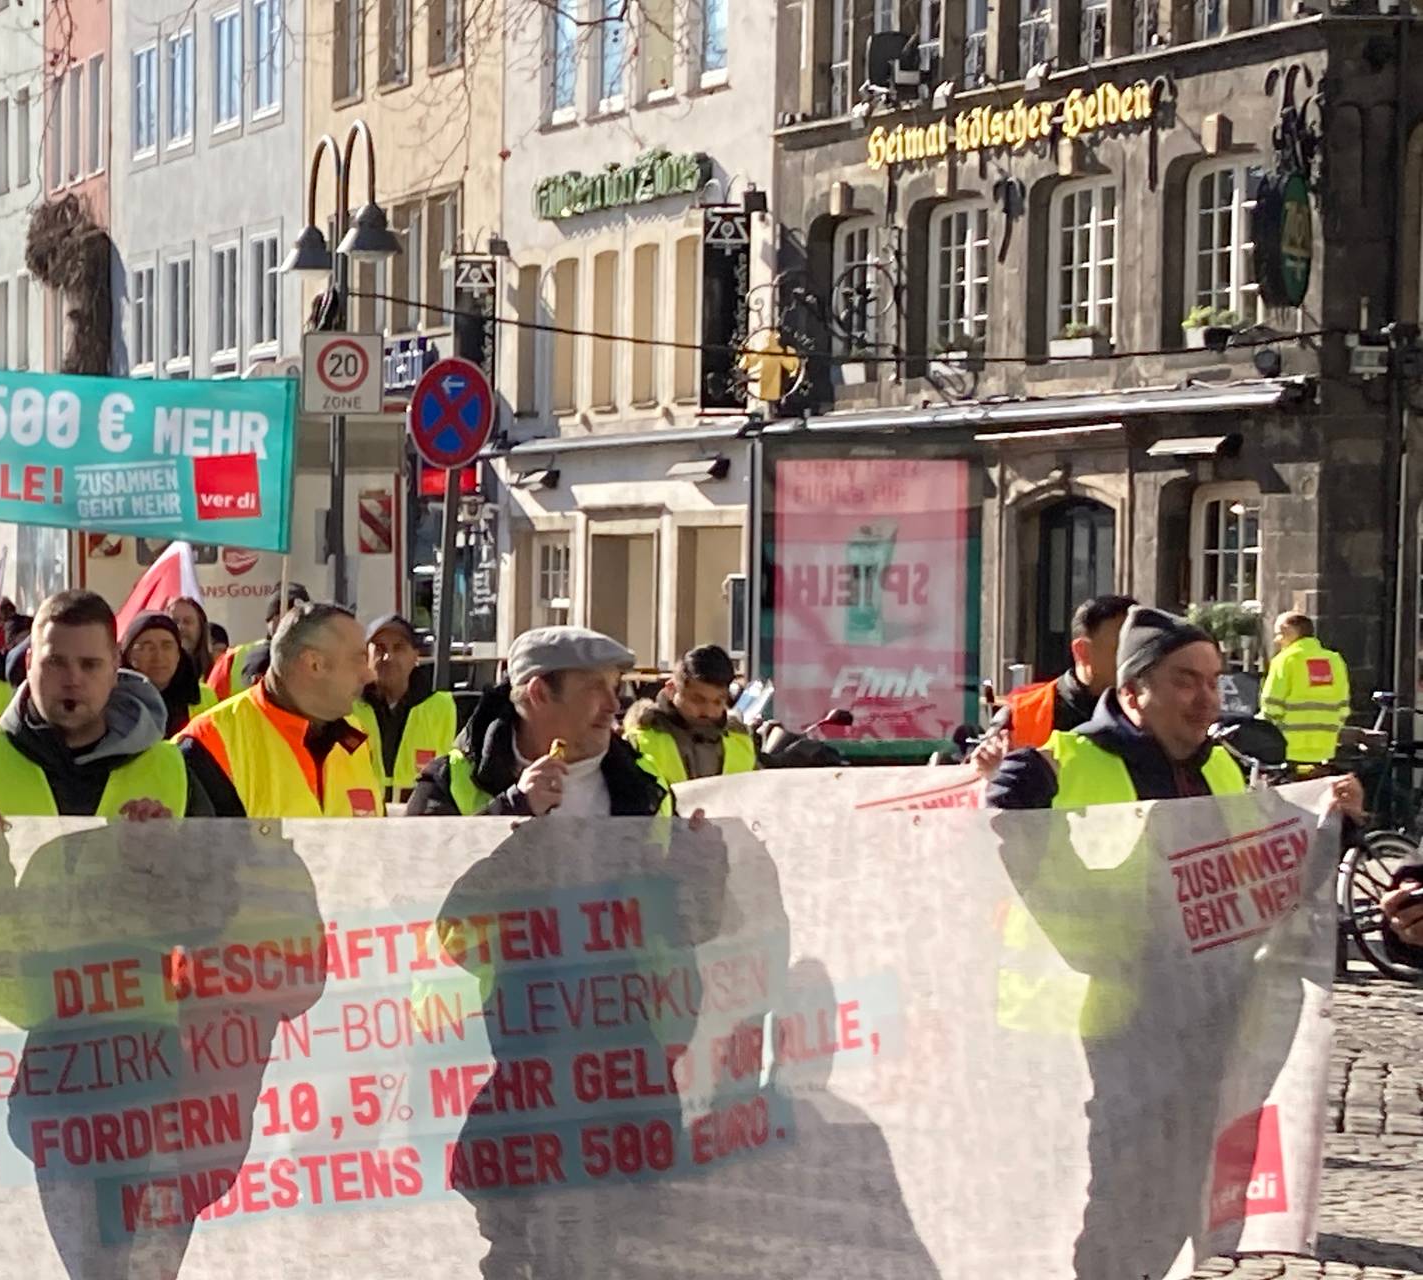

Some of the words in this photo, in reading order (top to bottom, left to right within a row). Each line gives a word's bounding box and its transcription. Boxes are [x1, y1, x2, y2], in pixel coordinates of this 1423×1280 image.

[867, 116, 947, 170] Heimat
[1063, 81, 1153, 138] Helden
[329, 353, 359, 377] 20
[98, 392, 135, 453] €
[153, 406, 269, 459] MEHR
[322, 396, 362, 410] ZONE
[75, 467, 179, 496] ZUSAMMEN
[77, 497, 126, 518] GEHT
[132, 493, 182, 516] MEHR
[200, 493, 231, 507] ver
[237, 493, 256, 509] di
[1171, 829, 1309, 903] ZUSAMMEN
[1182, 892, 1244, 941] GEHT
[53, 957, 144, 1019] DIE
[162, 905, 562, 1002] BESCHÄFTIGTEN
[579, 898, 643, 952] IM
[31, 1093, 242, 1168] FORDERN
[259, 1074, 414, 1141] 10,5%
[429, 1058, 554, 1119] MEHR
[571, 1043, 697, 1103] GELD
[710, 1020, 767, 1080] FÜR
[777, 999, 881, 1066] ALLE,
[121, 1147, 423, 1232] MINDESTENS
[444, 1132, 567, 1192] ABER
[581, 1119, 675, 1177] 500
[691, 1096, 787, 1165] EURO.
[1245, 1172, 1277, 1200] di
